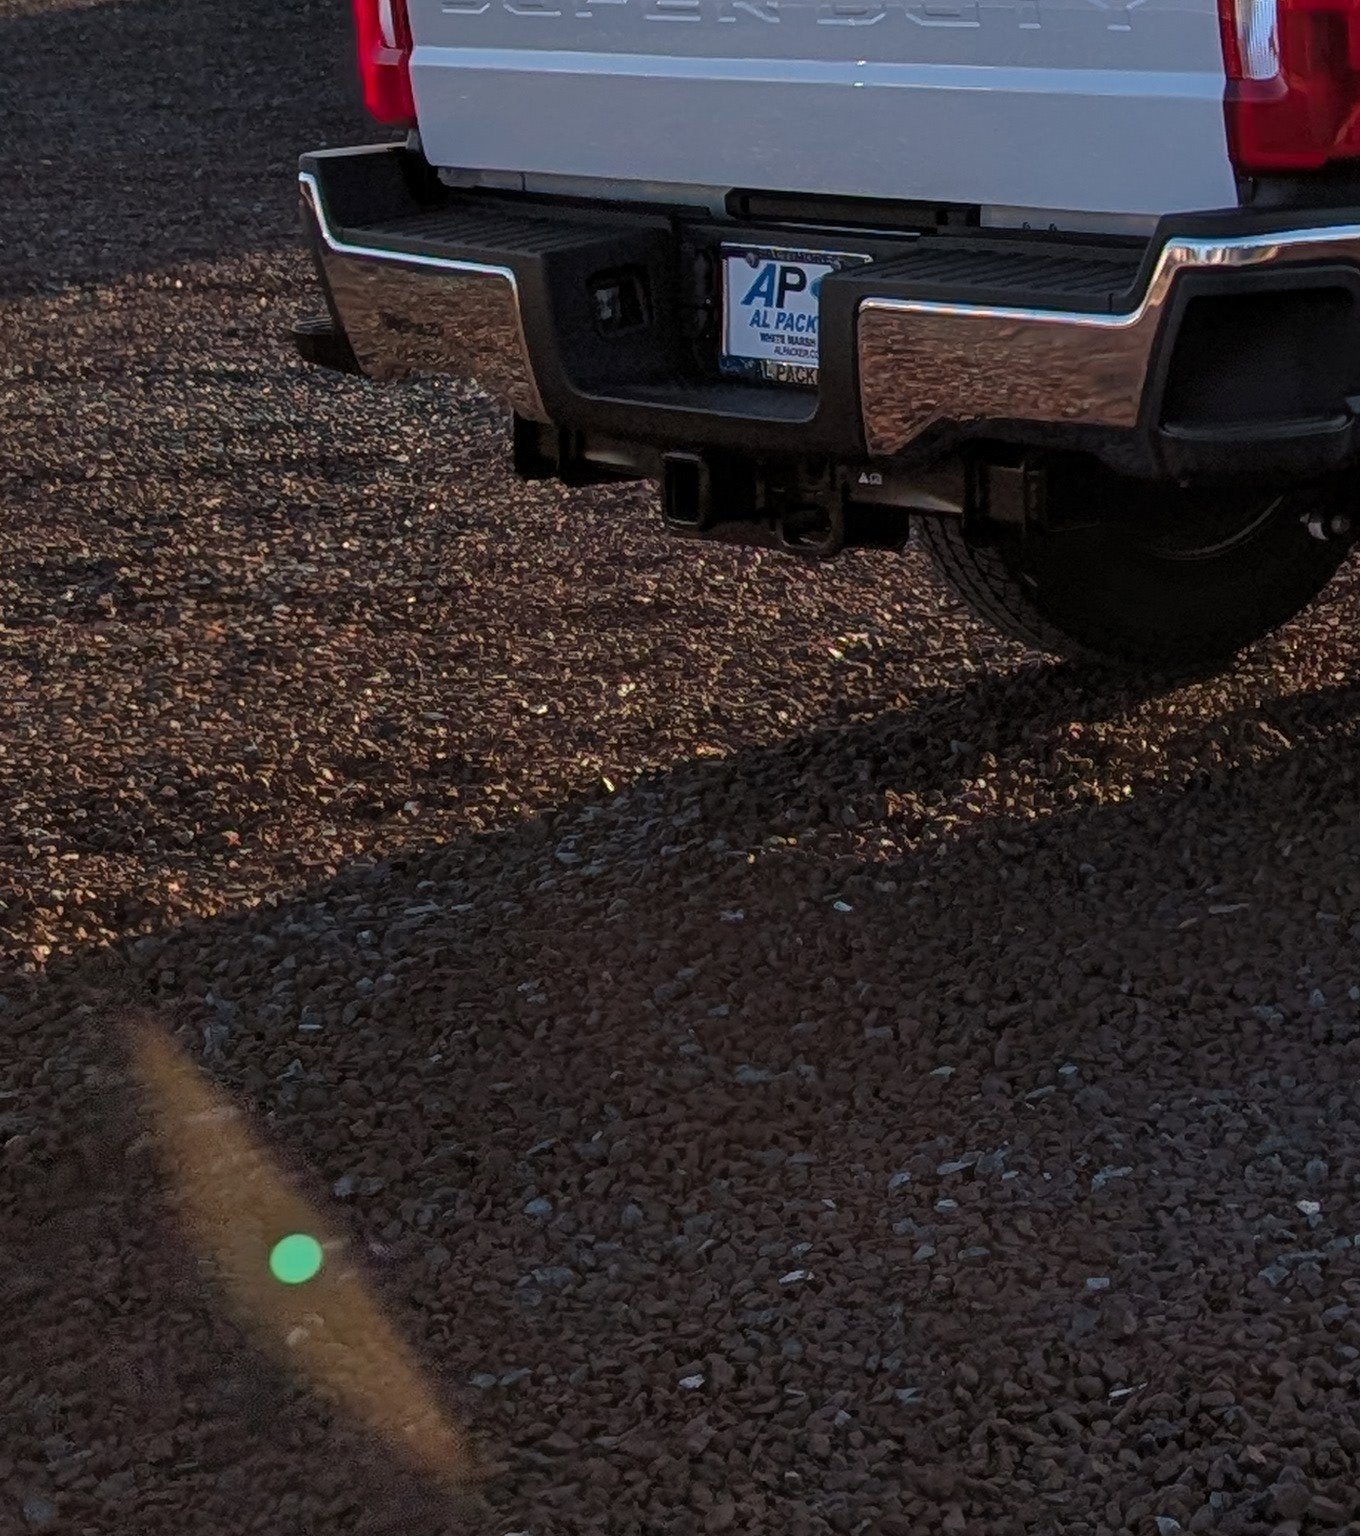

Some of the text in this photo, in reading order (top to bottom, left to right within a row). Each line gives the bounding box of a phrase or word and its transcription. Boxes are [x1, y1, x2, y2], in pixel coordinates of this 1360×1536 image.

[740, 263, 807, 309] AP
[749, 309, 819, 334] AL PACK
[760, 332, 786, 345] WHITE
[774, 346, 819, 359] ALPACKER.CO
[778, 363, 817, 385] PACK
